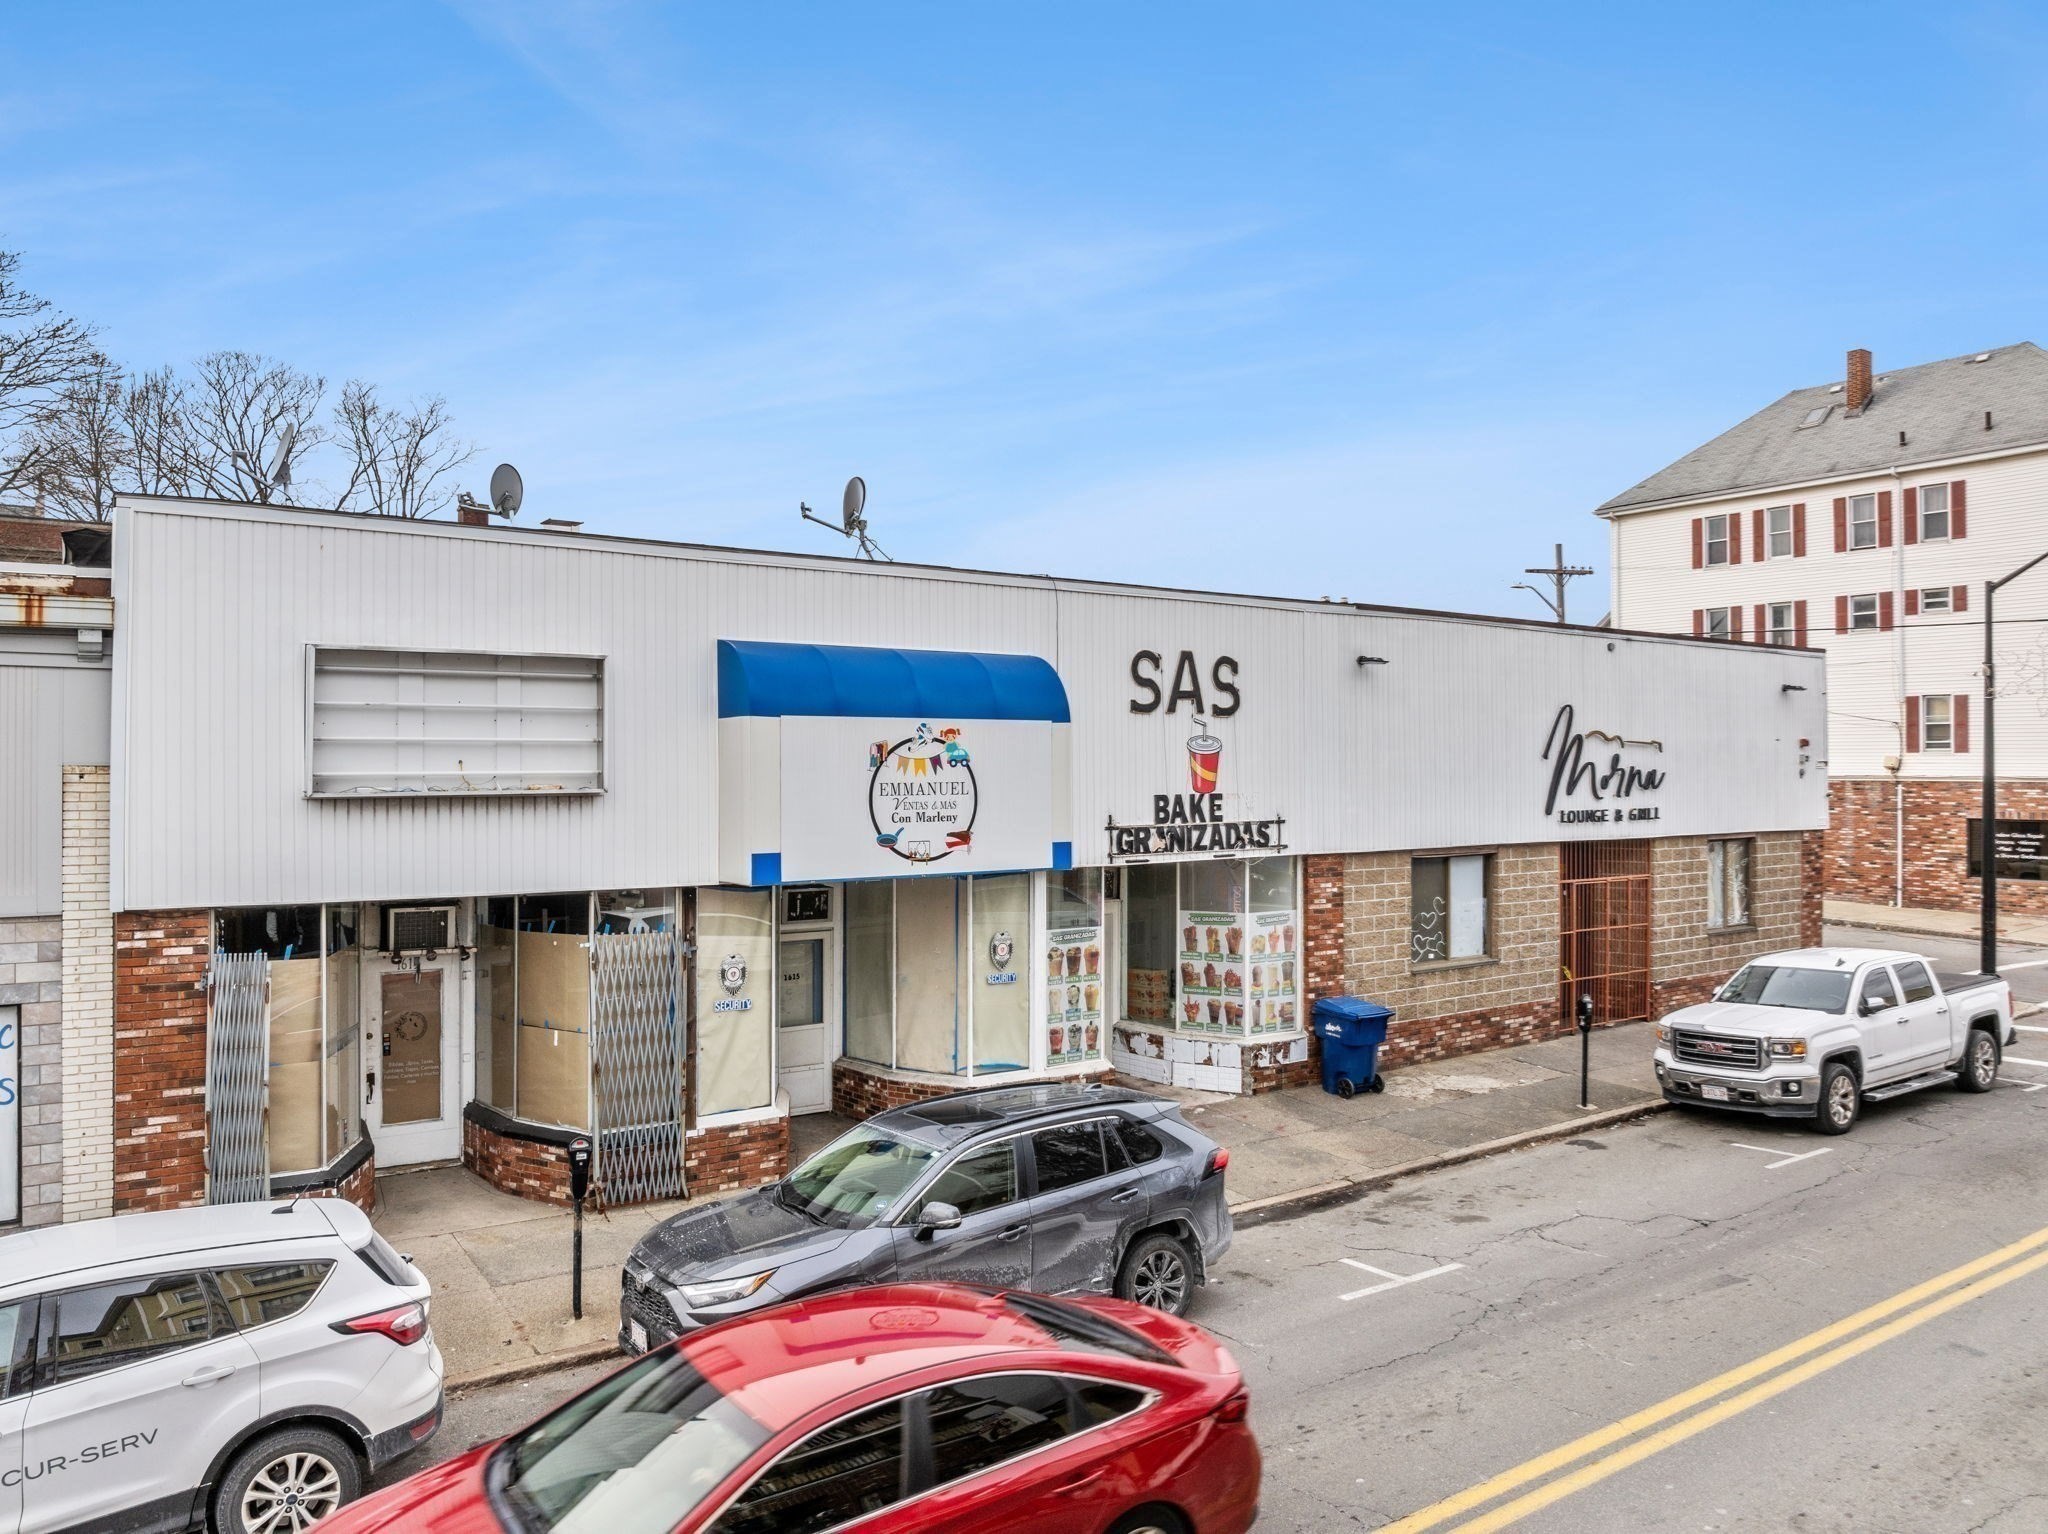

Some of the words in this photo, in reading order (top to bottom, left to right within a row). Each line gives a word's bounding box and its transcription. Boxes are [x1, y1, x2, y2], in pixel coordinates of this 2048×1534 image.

[1130, 649, 1241, 718] SAS
[1541, 704, 1666, 816] Morna
[879, 781, 969, 797] EMMANUEL
[892, 796, 929, 811] VENTAS
[1153, 793, 1224, 826] BAKE
[891, 811, 912, 824] Con
[915, 811, 959, 825] Marleny
[1559, 809, 1610, 824] LOUNGE
[1614, 808, 1623, 822] &
[1628, 806, 1661, 821] GRILL
[986, 972, 1017, 985] SECURITY
[714, 998, 752, 1013] SECURITY
[1, 1428, 158, 1487] CUR-SERV
